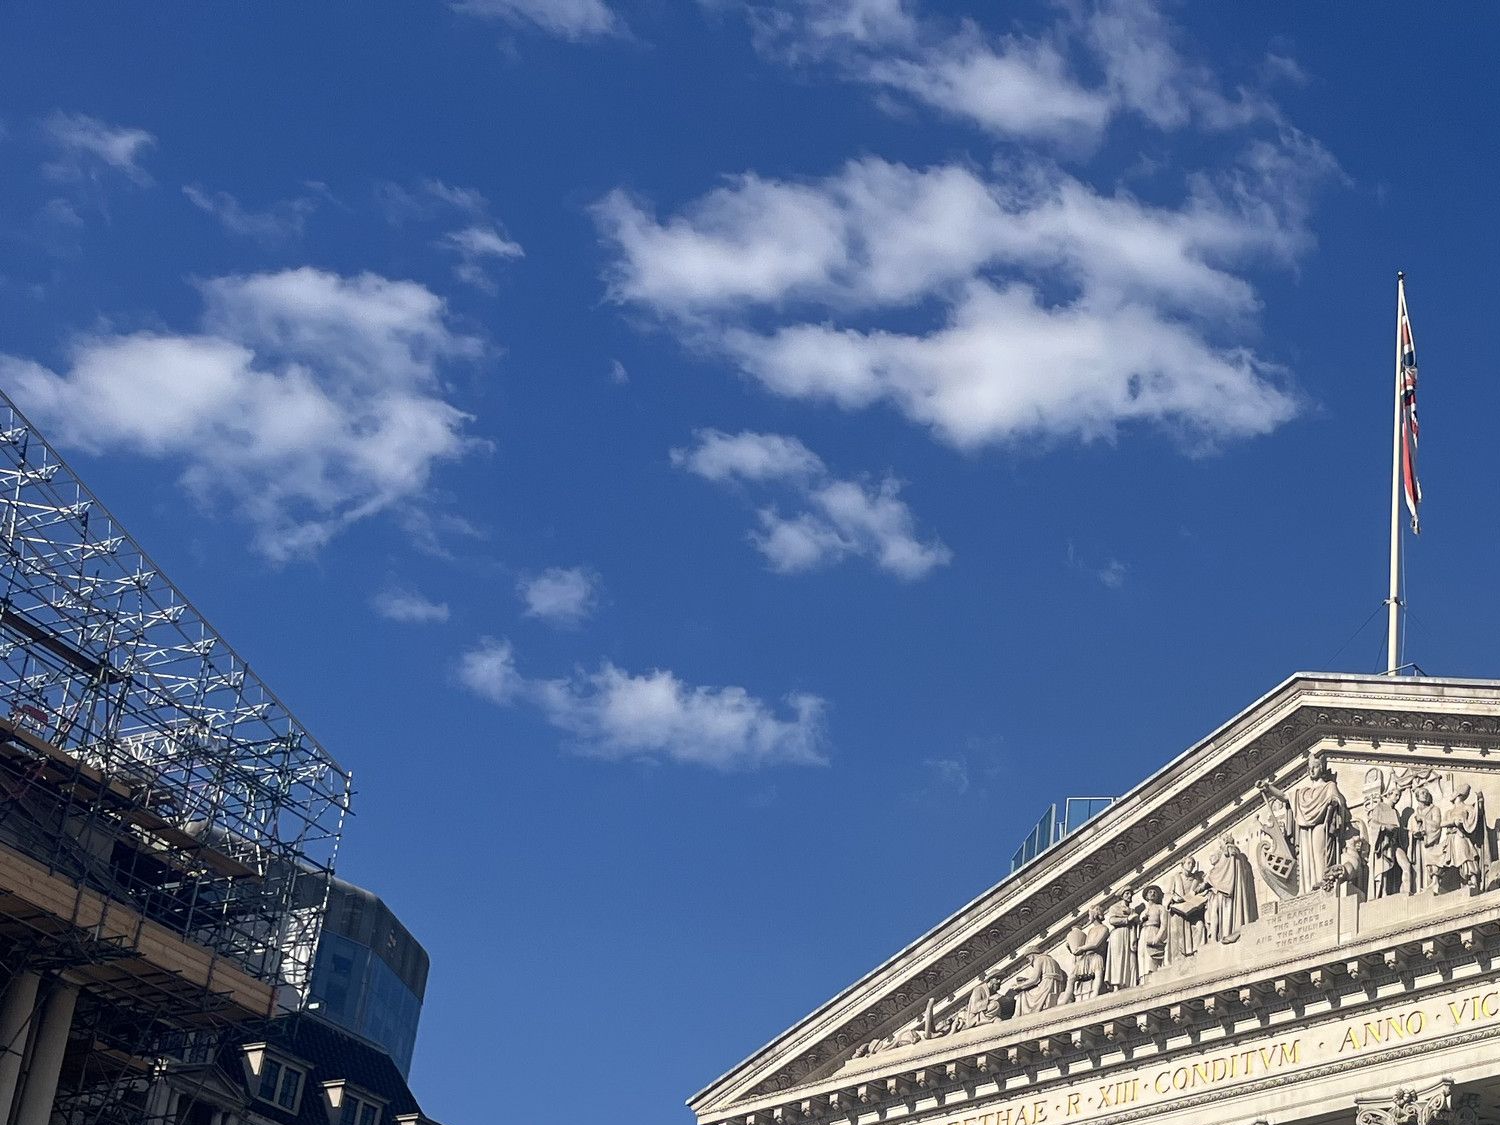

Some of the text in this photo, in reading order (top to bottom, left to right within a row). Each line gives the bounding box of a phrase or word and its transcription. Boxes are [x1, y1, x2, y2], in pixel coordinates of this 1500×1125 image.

[1066, 1092, 1082, 1116] R
[1097, 1079, 1139, 1109] XIII
[1154, 1039, 1301, 1094] CONDITVM
[1339, 1010, 1427, 1053] ANNO
